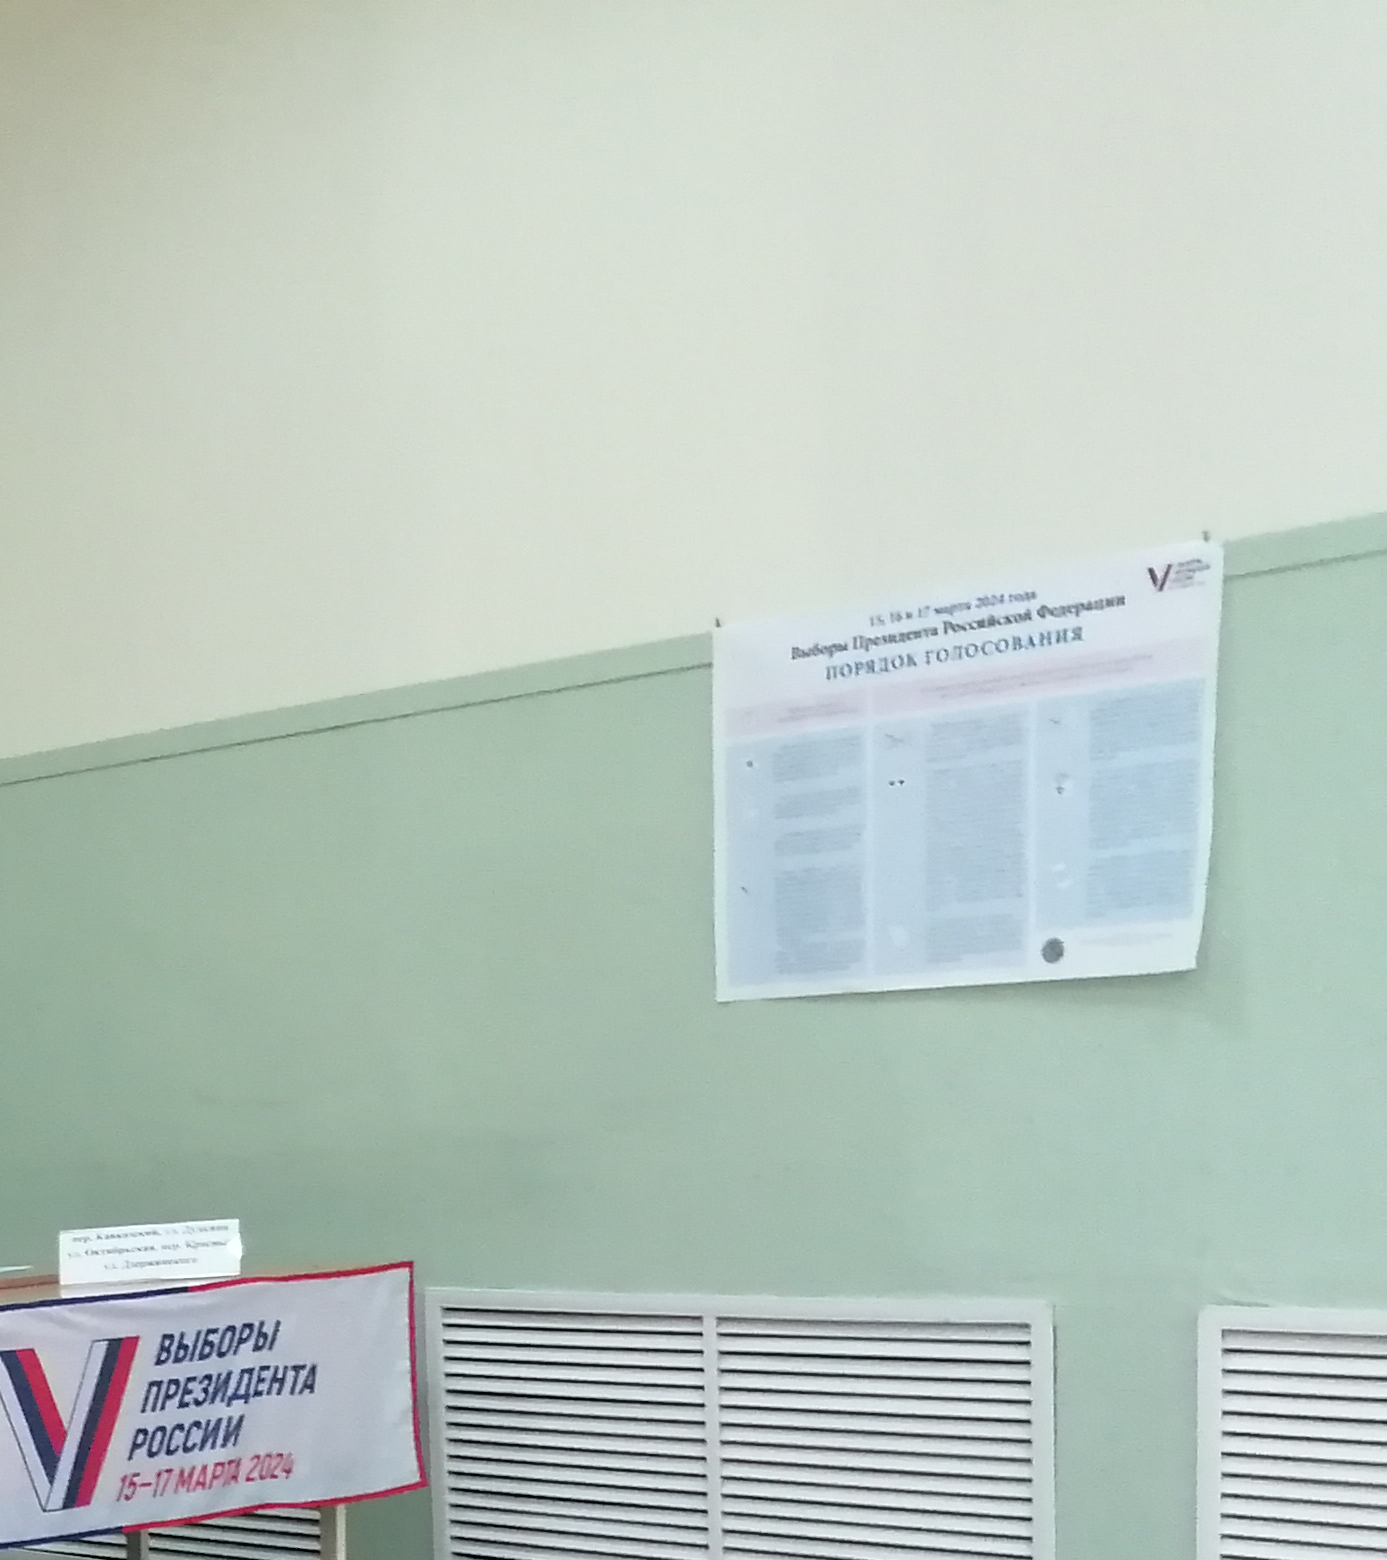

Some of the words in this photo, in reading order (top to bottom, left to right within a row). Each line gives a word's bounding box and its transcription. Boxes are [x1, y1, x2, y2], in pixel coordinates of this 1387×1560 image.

[791, 642, 848, 661] Выборы
[852, 626, 939, 652] Президента
[943, 608, 1032, 636] Российской
[1036, 594, 1126, 618] Федерации
[826, 653, 917, 681] ПОРЯДОК
[925, 626, 1084, 666] ГОЛОСОВАНИЯ
[155, 1320, 282, 1367] ВЫБОРЫ
[141, 1363, 318, 1414] ПРЕЗИДЕНТА
[128, 1414, 245, 1461] РОССИИ
[175, 1459, 240, 1496] МАРТА
[245, 1452, 295, 1484] 2024
